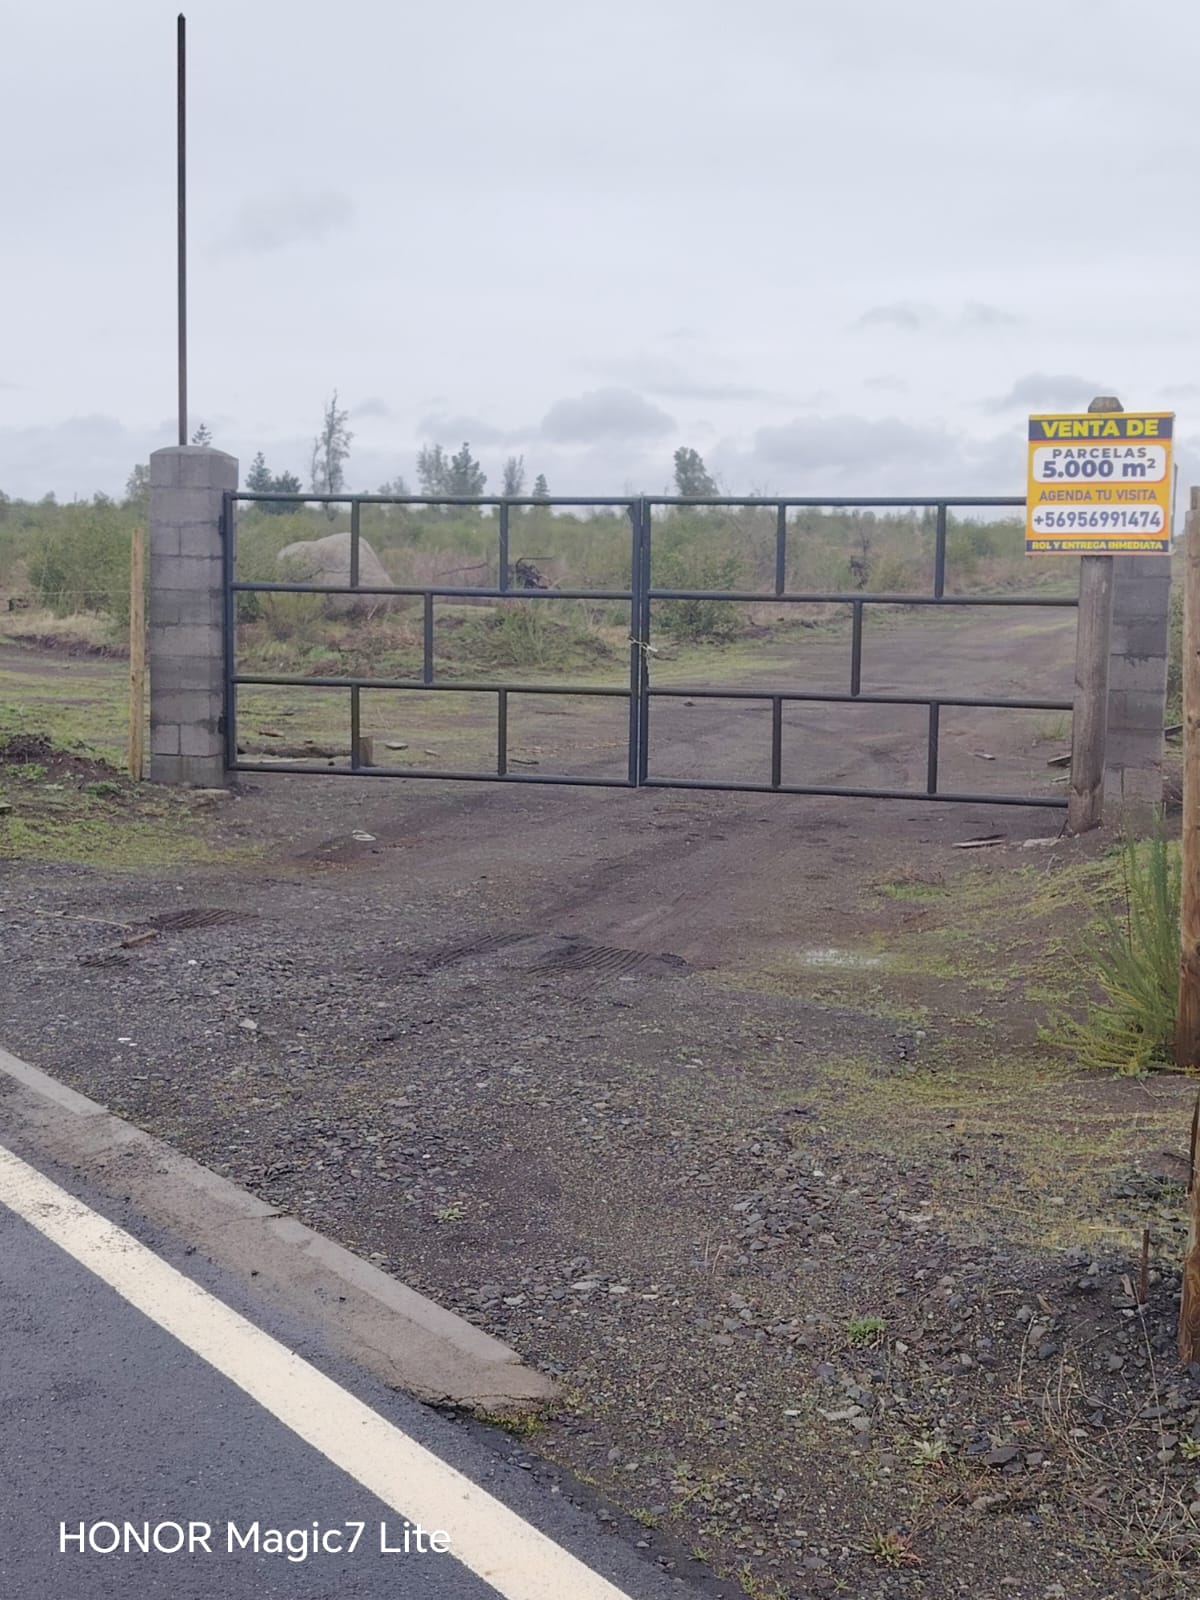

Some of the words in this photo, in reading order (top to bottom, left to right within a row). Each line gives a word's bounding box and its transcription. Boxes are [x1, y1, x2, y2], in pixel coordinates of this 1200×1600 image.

[1041, 420, 1120, 438] VENTA
[1126, 419, 1159, 437] DE
[1052, 447, 1147, 459] PARCELAS
[1042, 460, 1114, 478] 5.000
[1039, 489, 1092, 501] AGENDA
[1095, 489, 1112, 501] TU
[1116, 489, 1157, 501] VISITA
[1034, 511, 1161, 527] +56956991474
[1032, 542, 1053, 550] ROL
[1053, 542, 1061, 550] Y
[1062, 541, 1107, 550] ENTREGA
[1108, 541, 1163, 550] INMEDIATA
